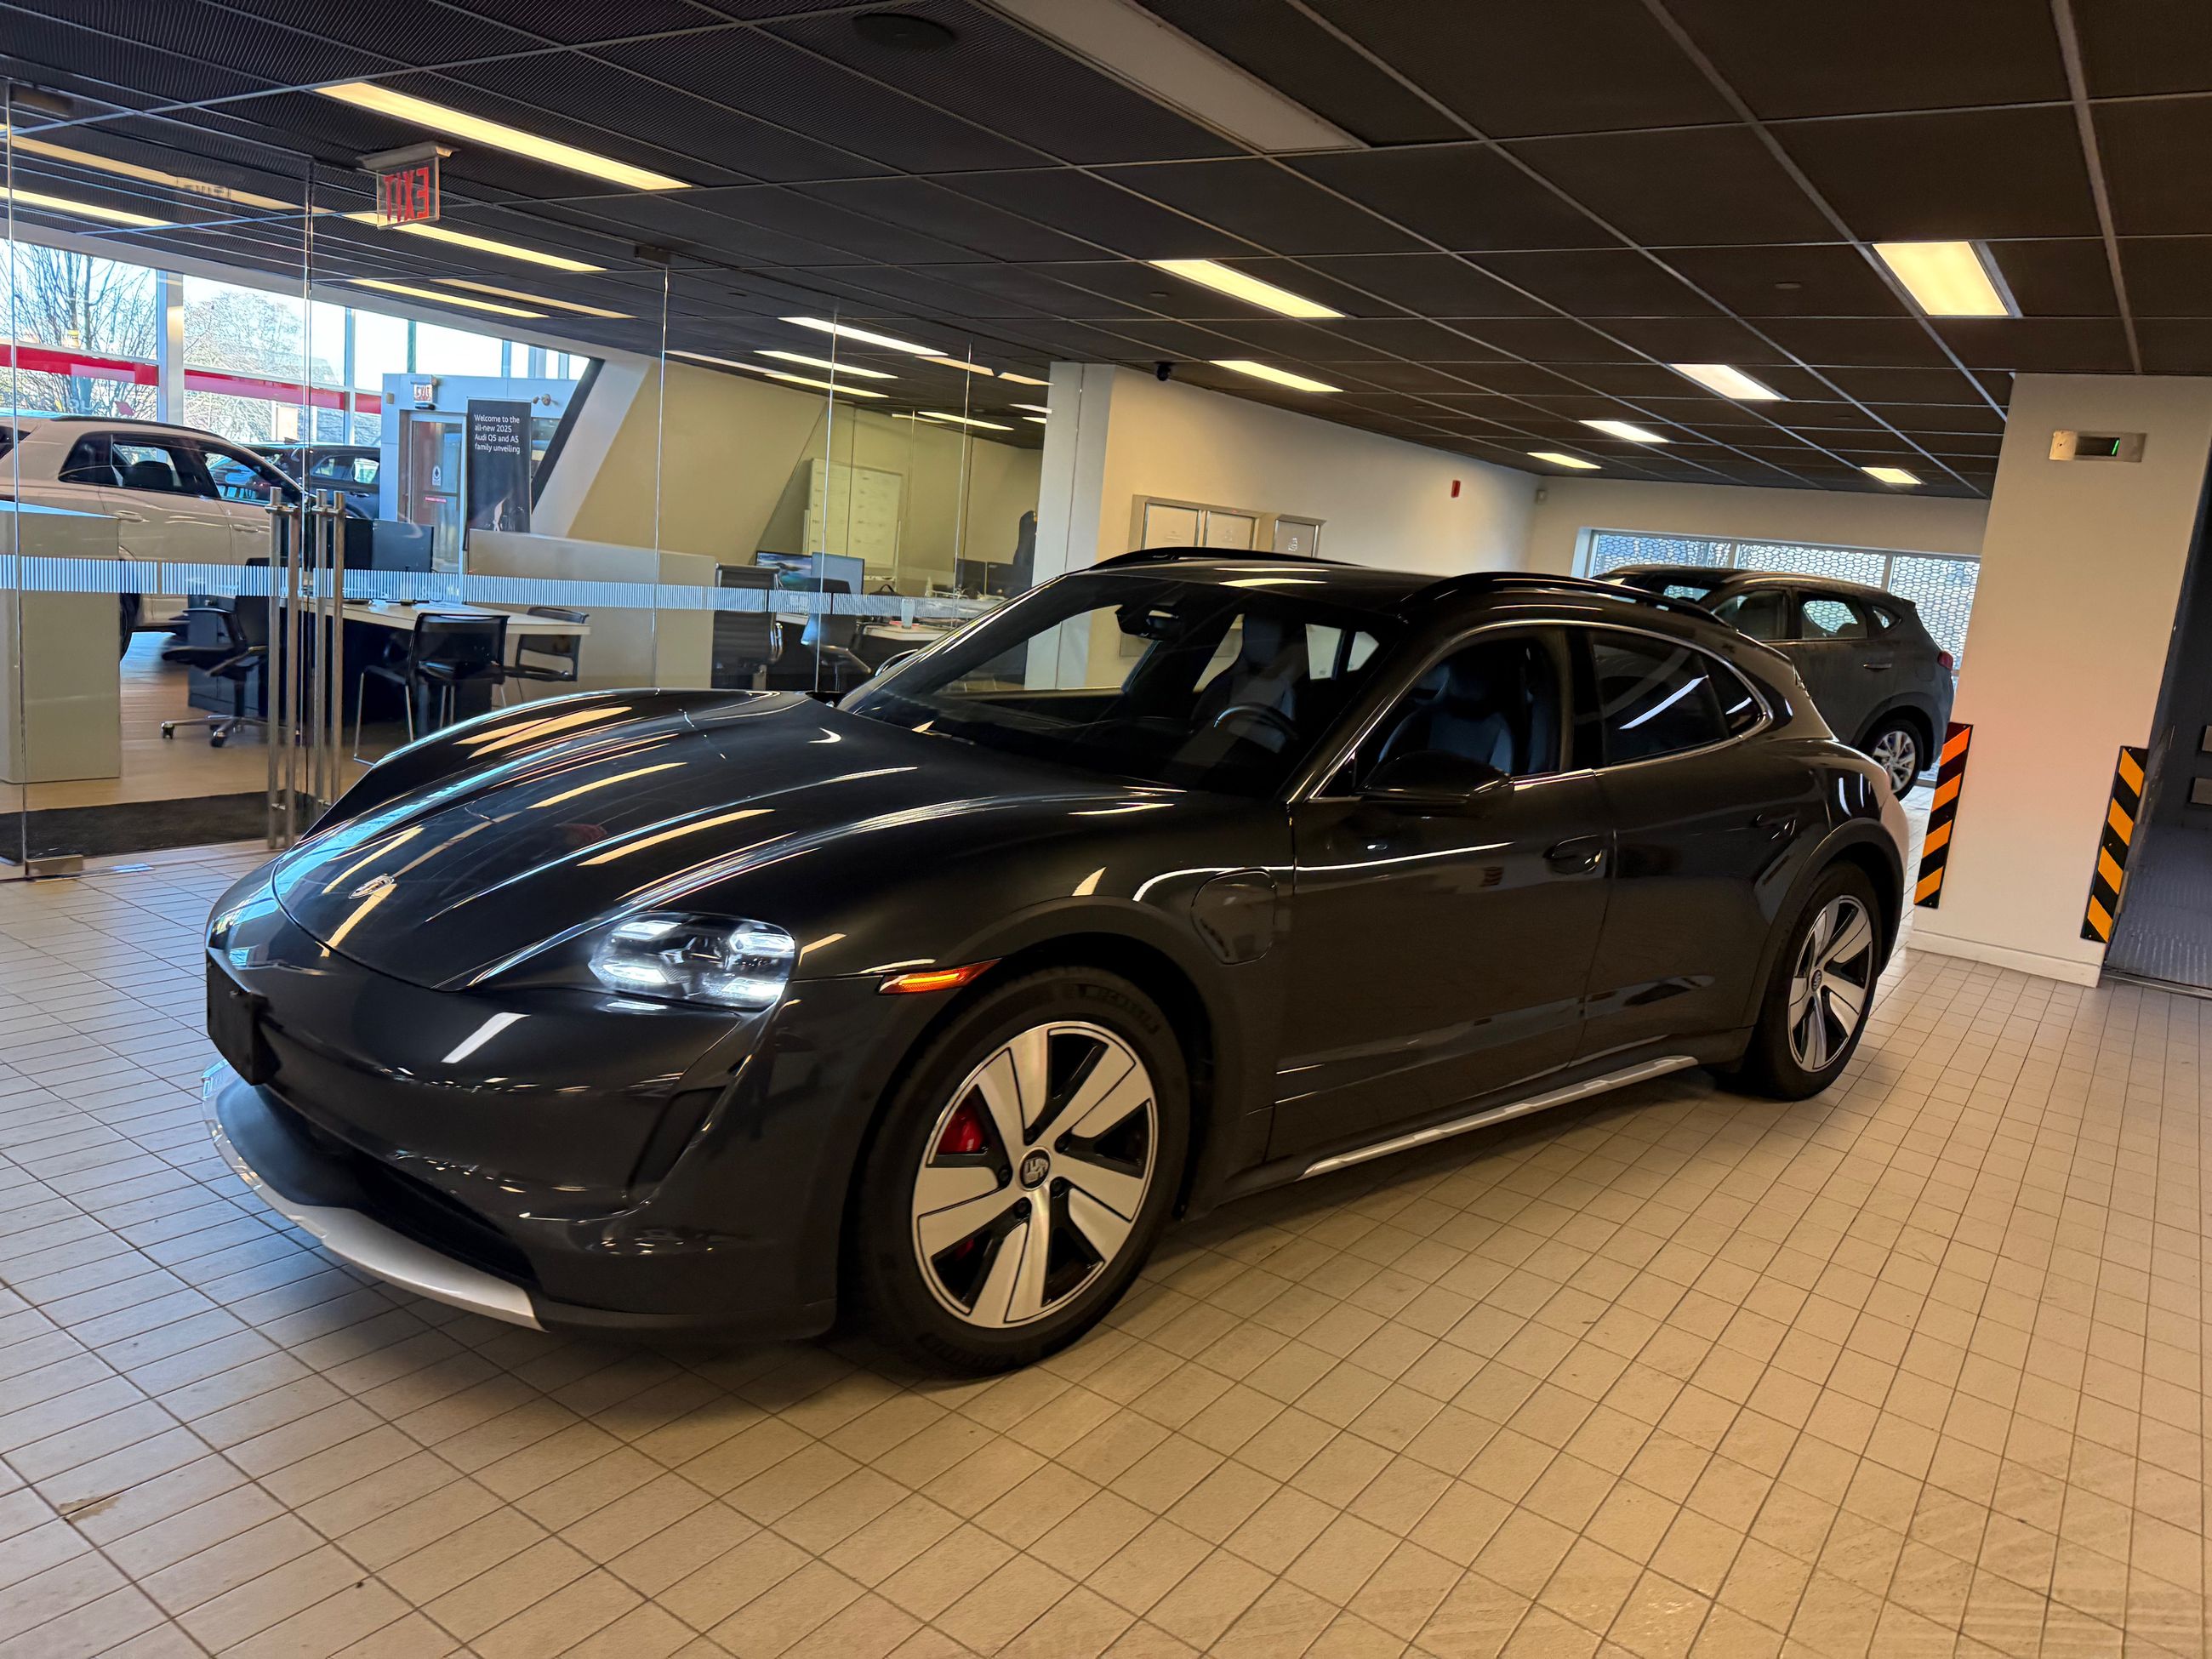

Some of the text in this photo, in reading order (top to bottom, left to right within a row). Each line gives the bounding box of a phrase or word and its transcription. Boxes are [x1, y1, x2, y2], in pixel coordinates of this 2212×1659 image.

[474, 414, 501, 423] Welcome
[510, 415, 520, 424] the
[496, 425, 512, 433] 2025
[487, 434, 497, 442] Q5
[510, 435, 519, 443] A5
[475, 442, 521, 455] family unveiling
